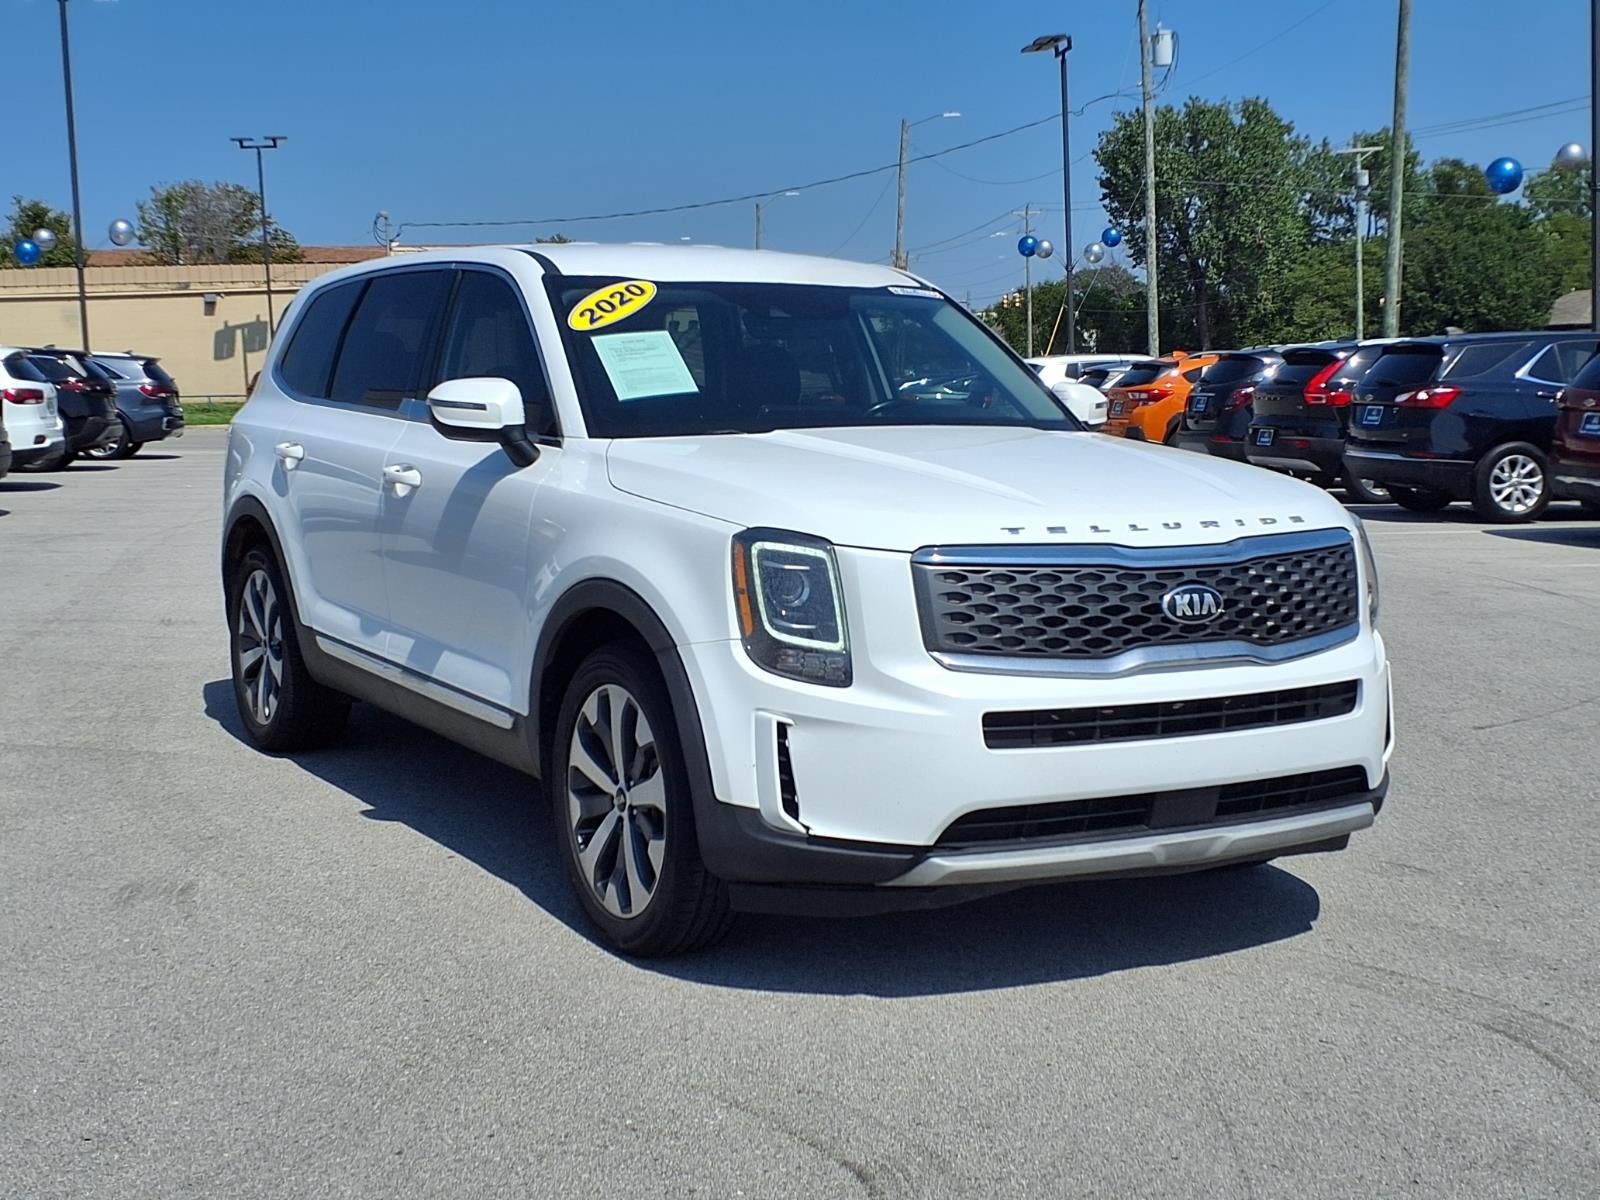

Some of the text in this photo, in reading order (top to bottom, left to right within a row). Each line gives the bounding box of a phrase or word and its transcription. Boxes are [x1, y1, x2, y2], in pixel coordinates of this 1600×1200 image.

[579, 284, 645, 325] 2020
[1000, 515, 1305, 535] TELLURIDE
[1174, 593, 1217, 617] KIA
